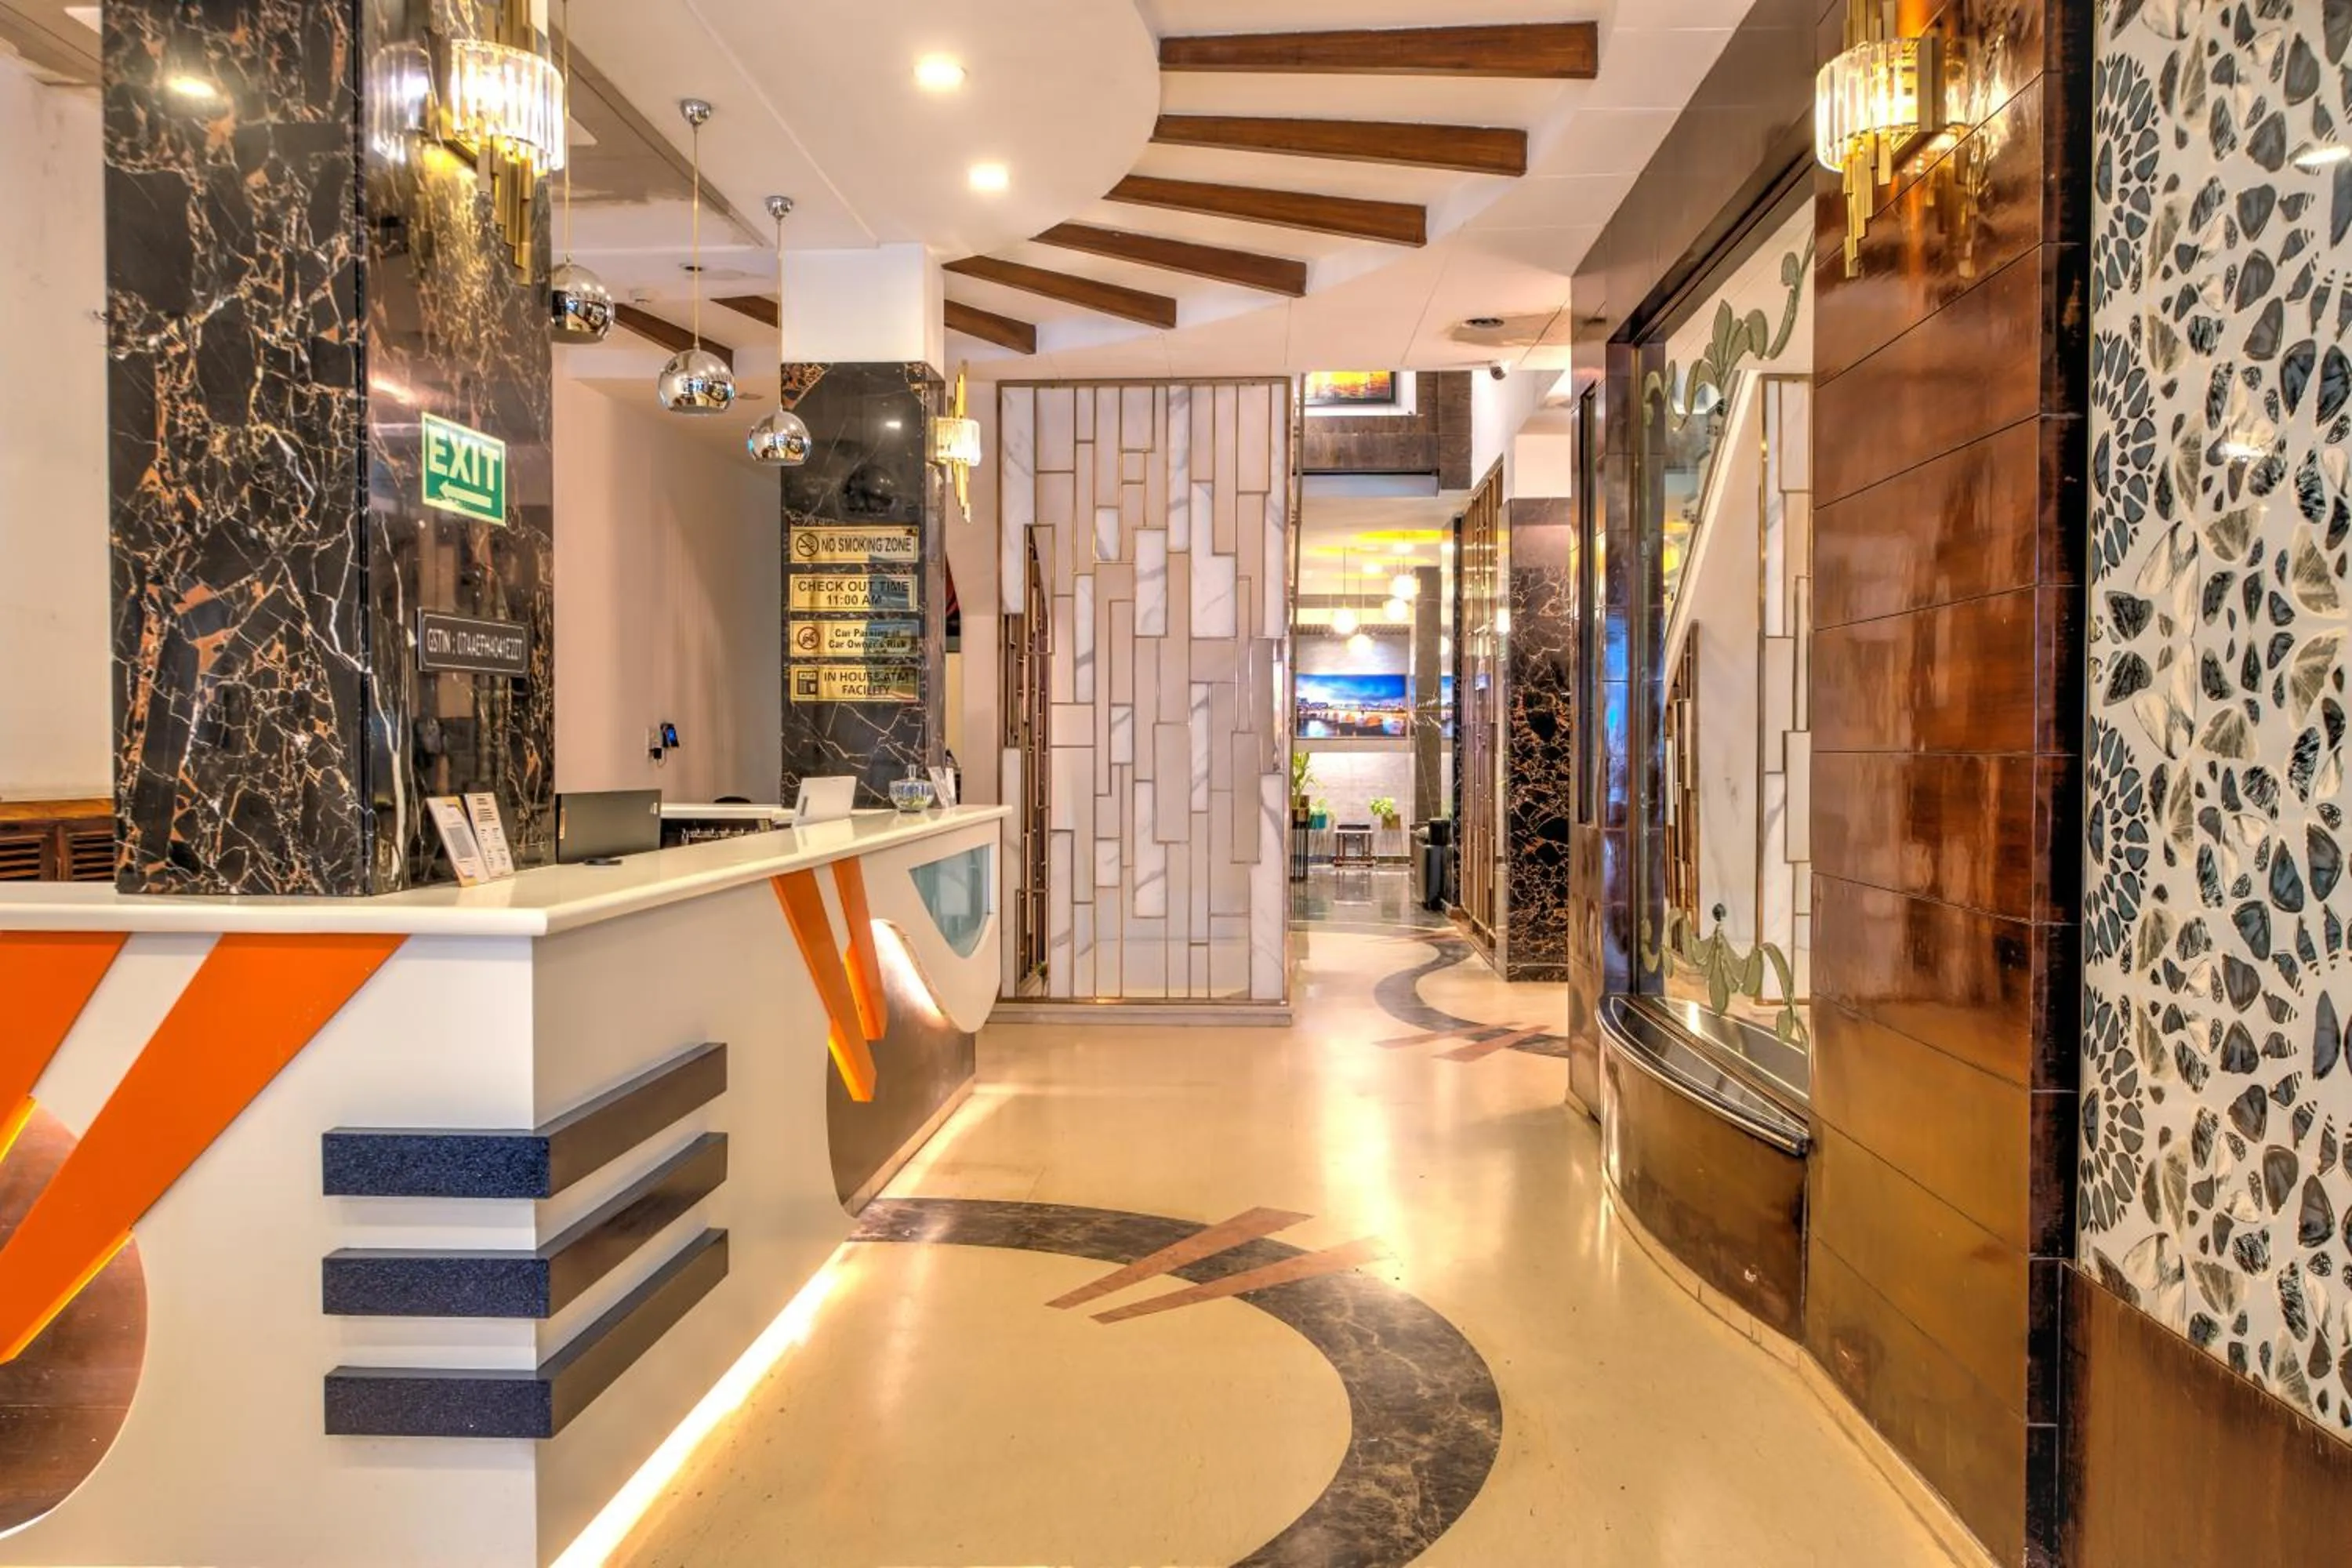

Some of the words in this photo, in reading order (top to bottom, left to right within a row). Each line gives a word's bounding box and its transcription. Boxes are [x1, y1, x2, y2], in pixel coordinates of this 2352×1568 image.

[427, 423, 500, 492] EXIT
[821, 537, 836, 552] NO
[838, 537, 882, 553] SMOKING
[884, 537, 912, 552] ZONE
[798, 580, 844, 592] CHECK
[848, 580, 873, 592] OUT
[880, 580, 909, 592] TIME
[826, 594, 858, 605] 11:00
[862, 594, 882, 605] AM
[427, 628, 451, 652] GSTIN
[824, 672, 836, 681] IN
[840, 672, 879, 682] HOUSE
[841, 684, 890, 695] FACILITY
